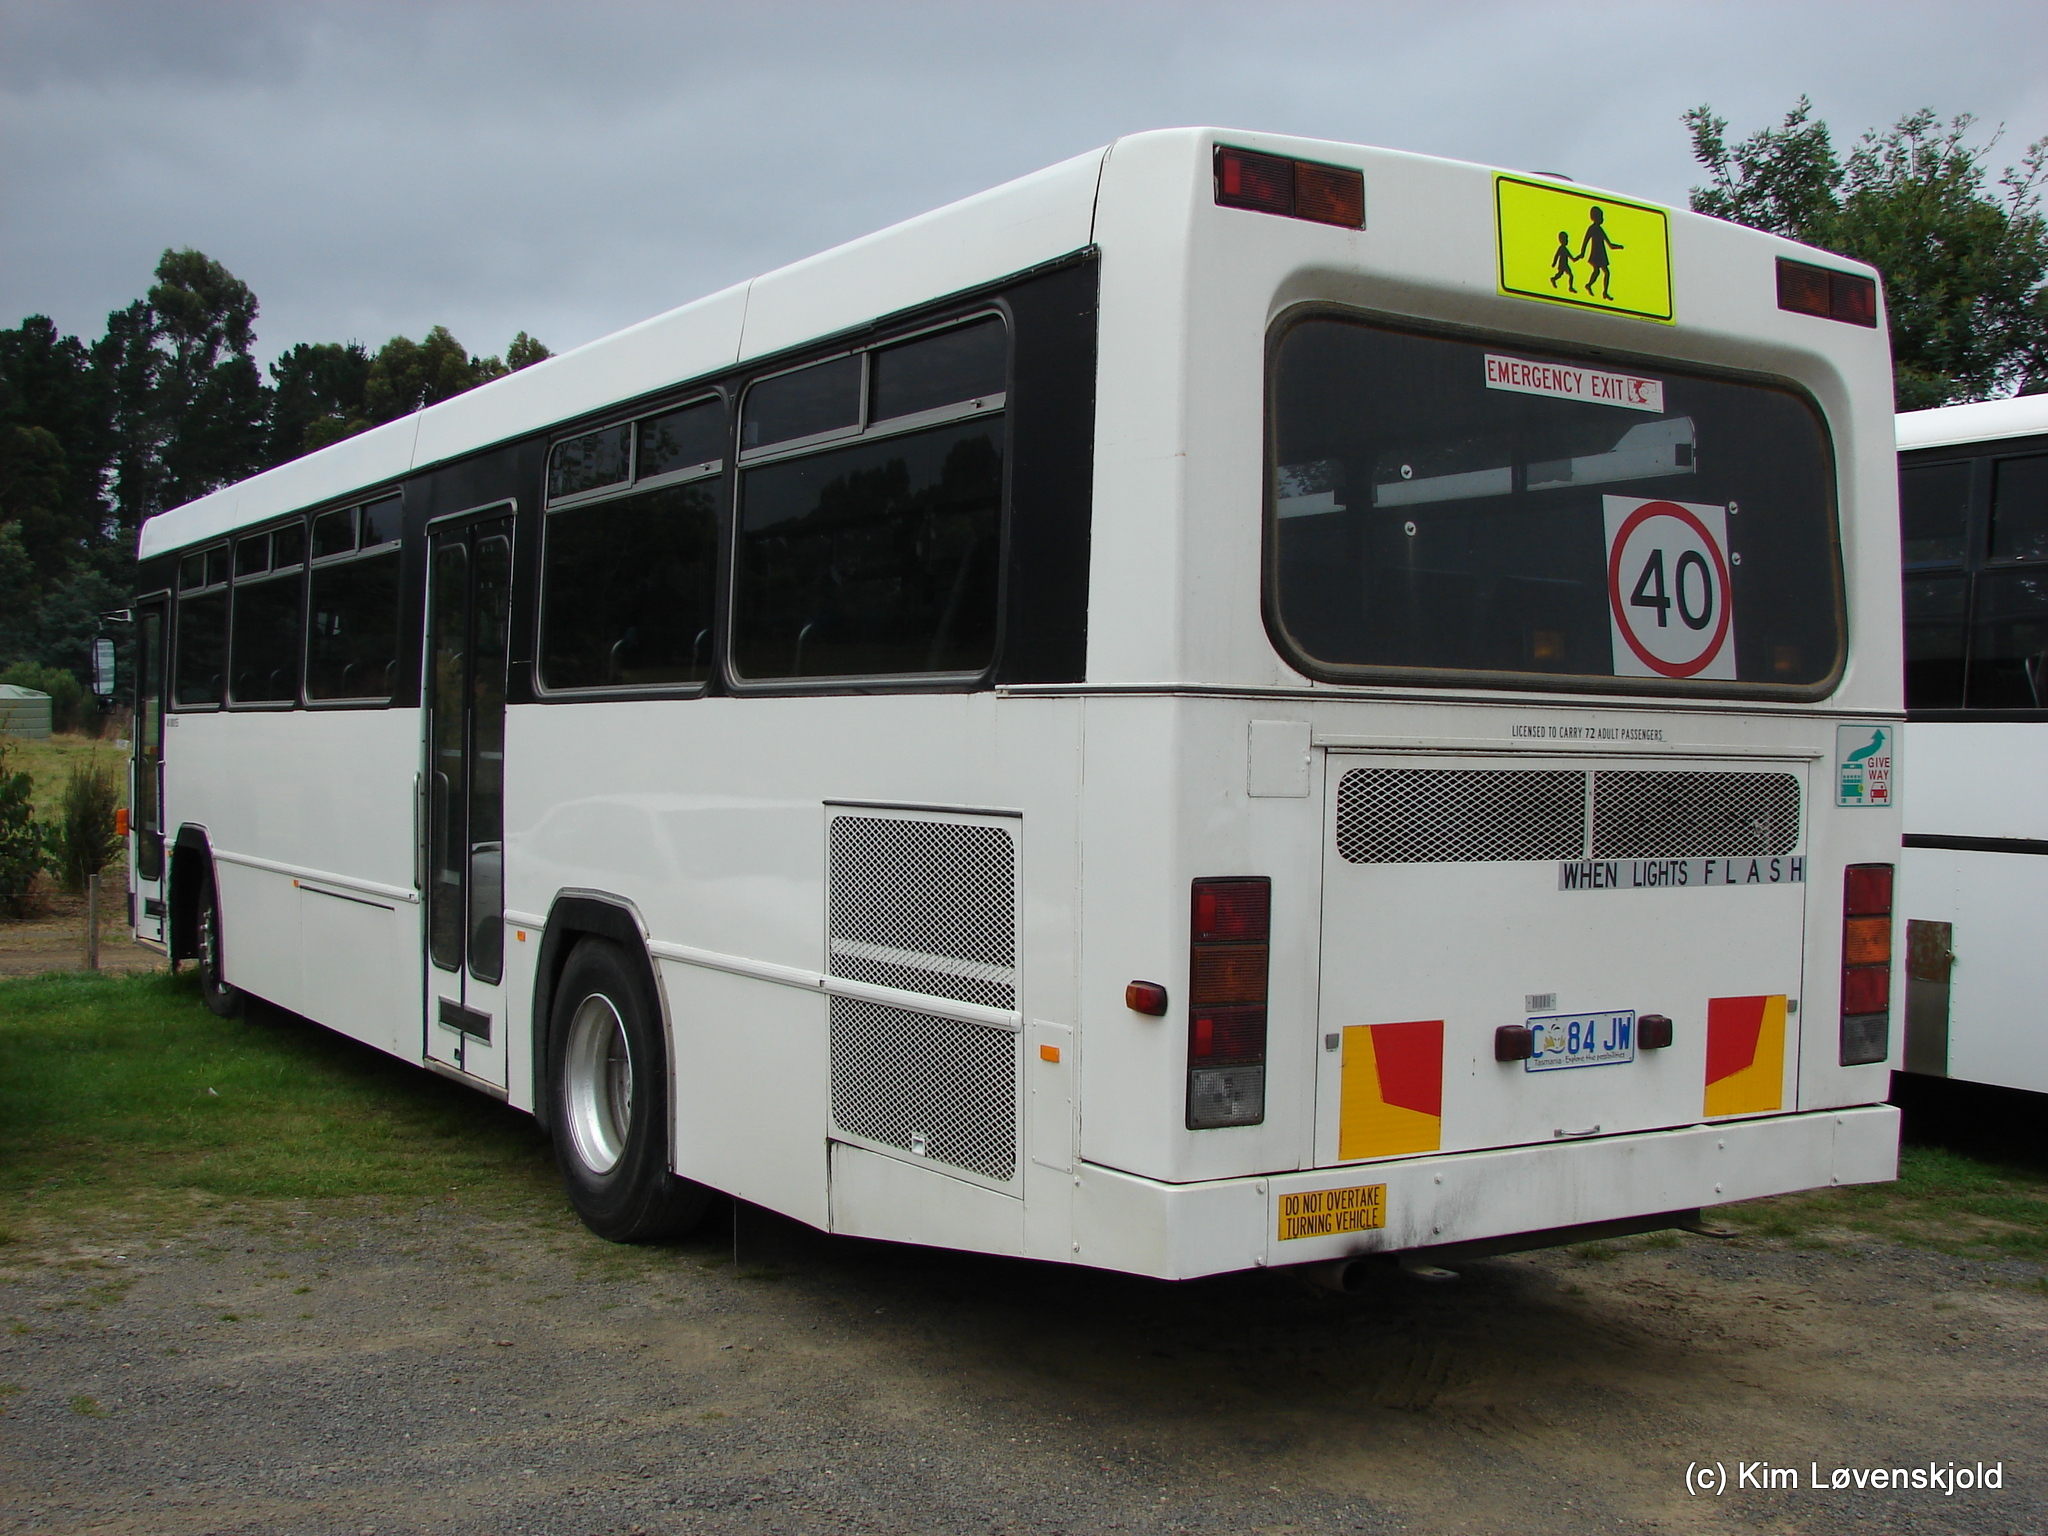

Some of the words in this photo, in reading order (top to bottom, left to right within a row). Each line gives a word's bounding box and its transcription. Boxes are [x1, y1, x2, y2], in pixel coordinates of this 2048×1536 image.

[1487, 360, 1582, 394] EMERGENCY
[1591, 375, 1623, 400] EXIT
[1630, 548, 1713, 631] 40
[1512, 725, 1546, 738] LICENSED
[1548, 726, 1557, 738] TO
[1559, 727, 1583, 739] CARRY
[1585, 727, 1595, 739] 72
[1597, 728, 1619, 740] ADULT
[1621, 729, 1663, 741] PASSENGERS
[1867, 757, 1891, 768] GIVE
[1868, 769, 1889, 781] WAY
[1563, 862, 1618, 890] WHEN
[1632, 860, 1688, 887] LIGHTS
[1531, 1024, 1544, 1059] C
[1567, 1020, 1595, 1054] 84
[1603, 1016, 1631, 1051] JW
[1285, 1195, 1299, 1216] DO
[1302, 1193, 1323, 1213] NOT
[1326, 1186, 1380, 1211] OVERTAKE
[1286, 1214, 1332, 1237] TURNING
[1335, 1207, 1379, 1231] VEHICLE
